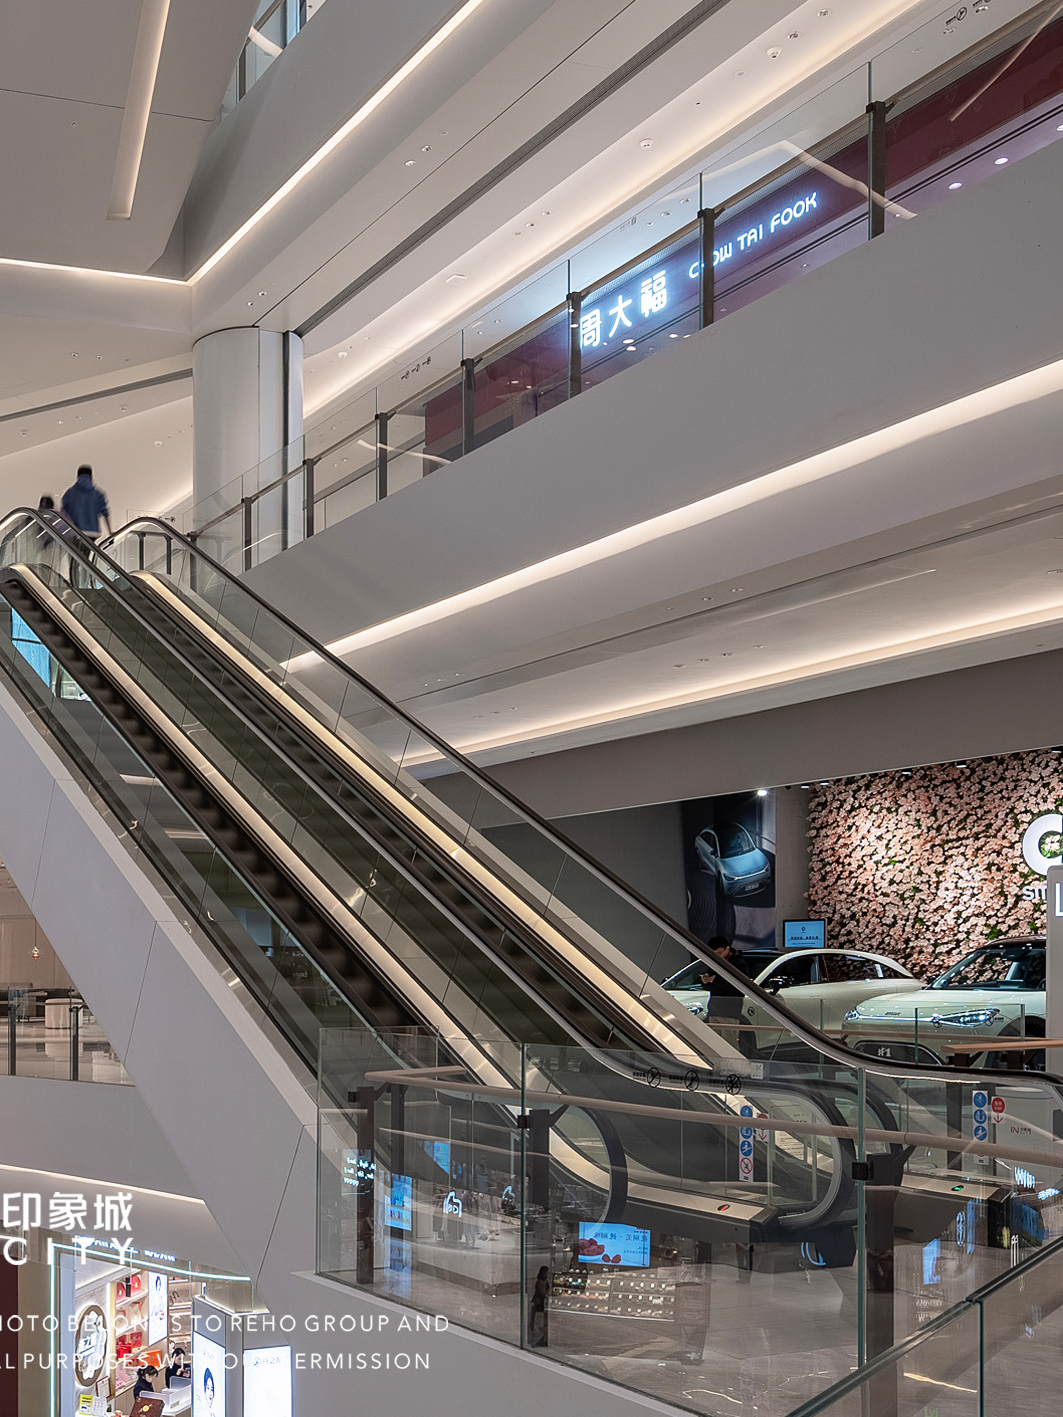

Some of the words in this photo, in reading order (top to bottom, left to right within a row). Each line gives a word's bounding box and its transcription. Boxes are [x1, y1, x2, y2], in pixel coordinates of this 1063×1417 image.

[689, 242, 732, 279] COW
[737, 224, 763, 251] TAI
[770, 192, 817, 233] FOOK
[580, 269, 668, 349] 周大福
